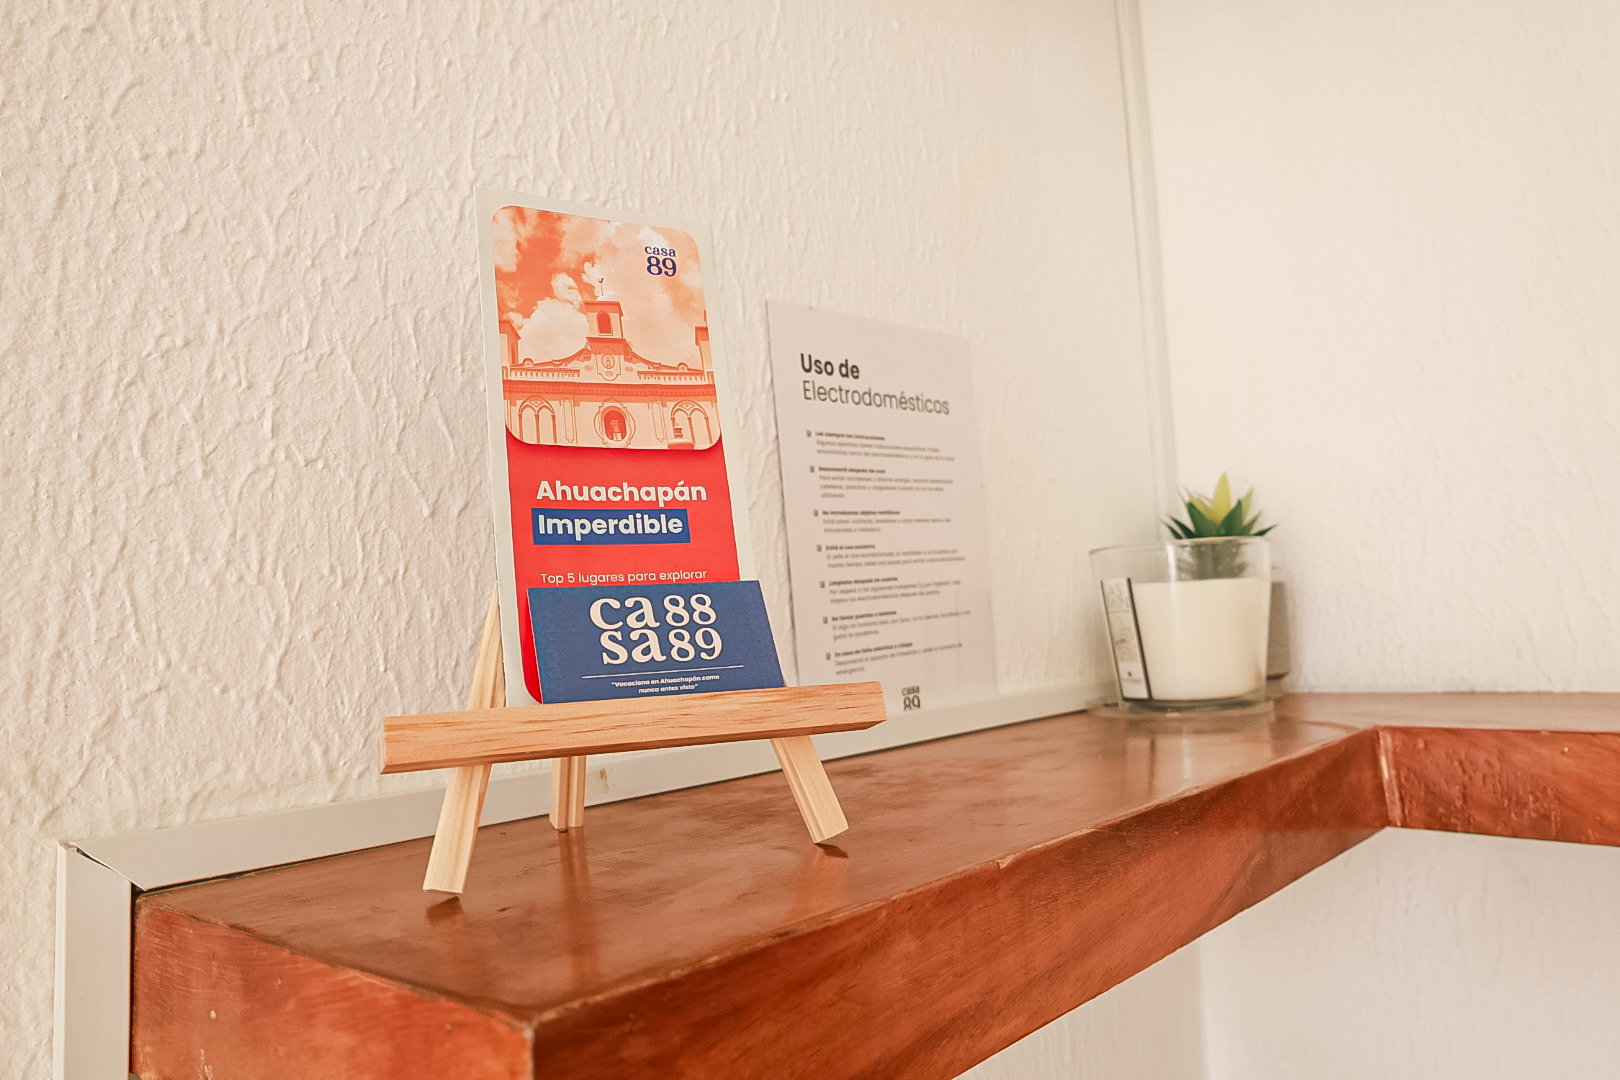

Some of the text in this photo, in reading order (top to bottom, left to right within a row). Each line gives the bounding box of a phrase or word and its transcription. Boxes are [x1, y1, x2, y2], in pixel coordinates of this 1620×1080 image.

[644, 245, 677, 257] casa
[646, 256, 677, 277] 89
[800, 353, 860, 379] Uso de
[802, 380, 950, 415] Electrodomésticos
[536, 480, 707, 507] Ahuachapán
[538, 513, 683, 541] Imperdible
[540, 570, 707, 585] Top 5 lugares para explorar
[589, 593, 717, 630] ca 88
[600, 627, 723, 665] sa 89
[660, 676, 701, 684] Ahuachapán
